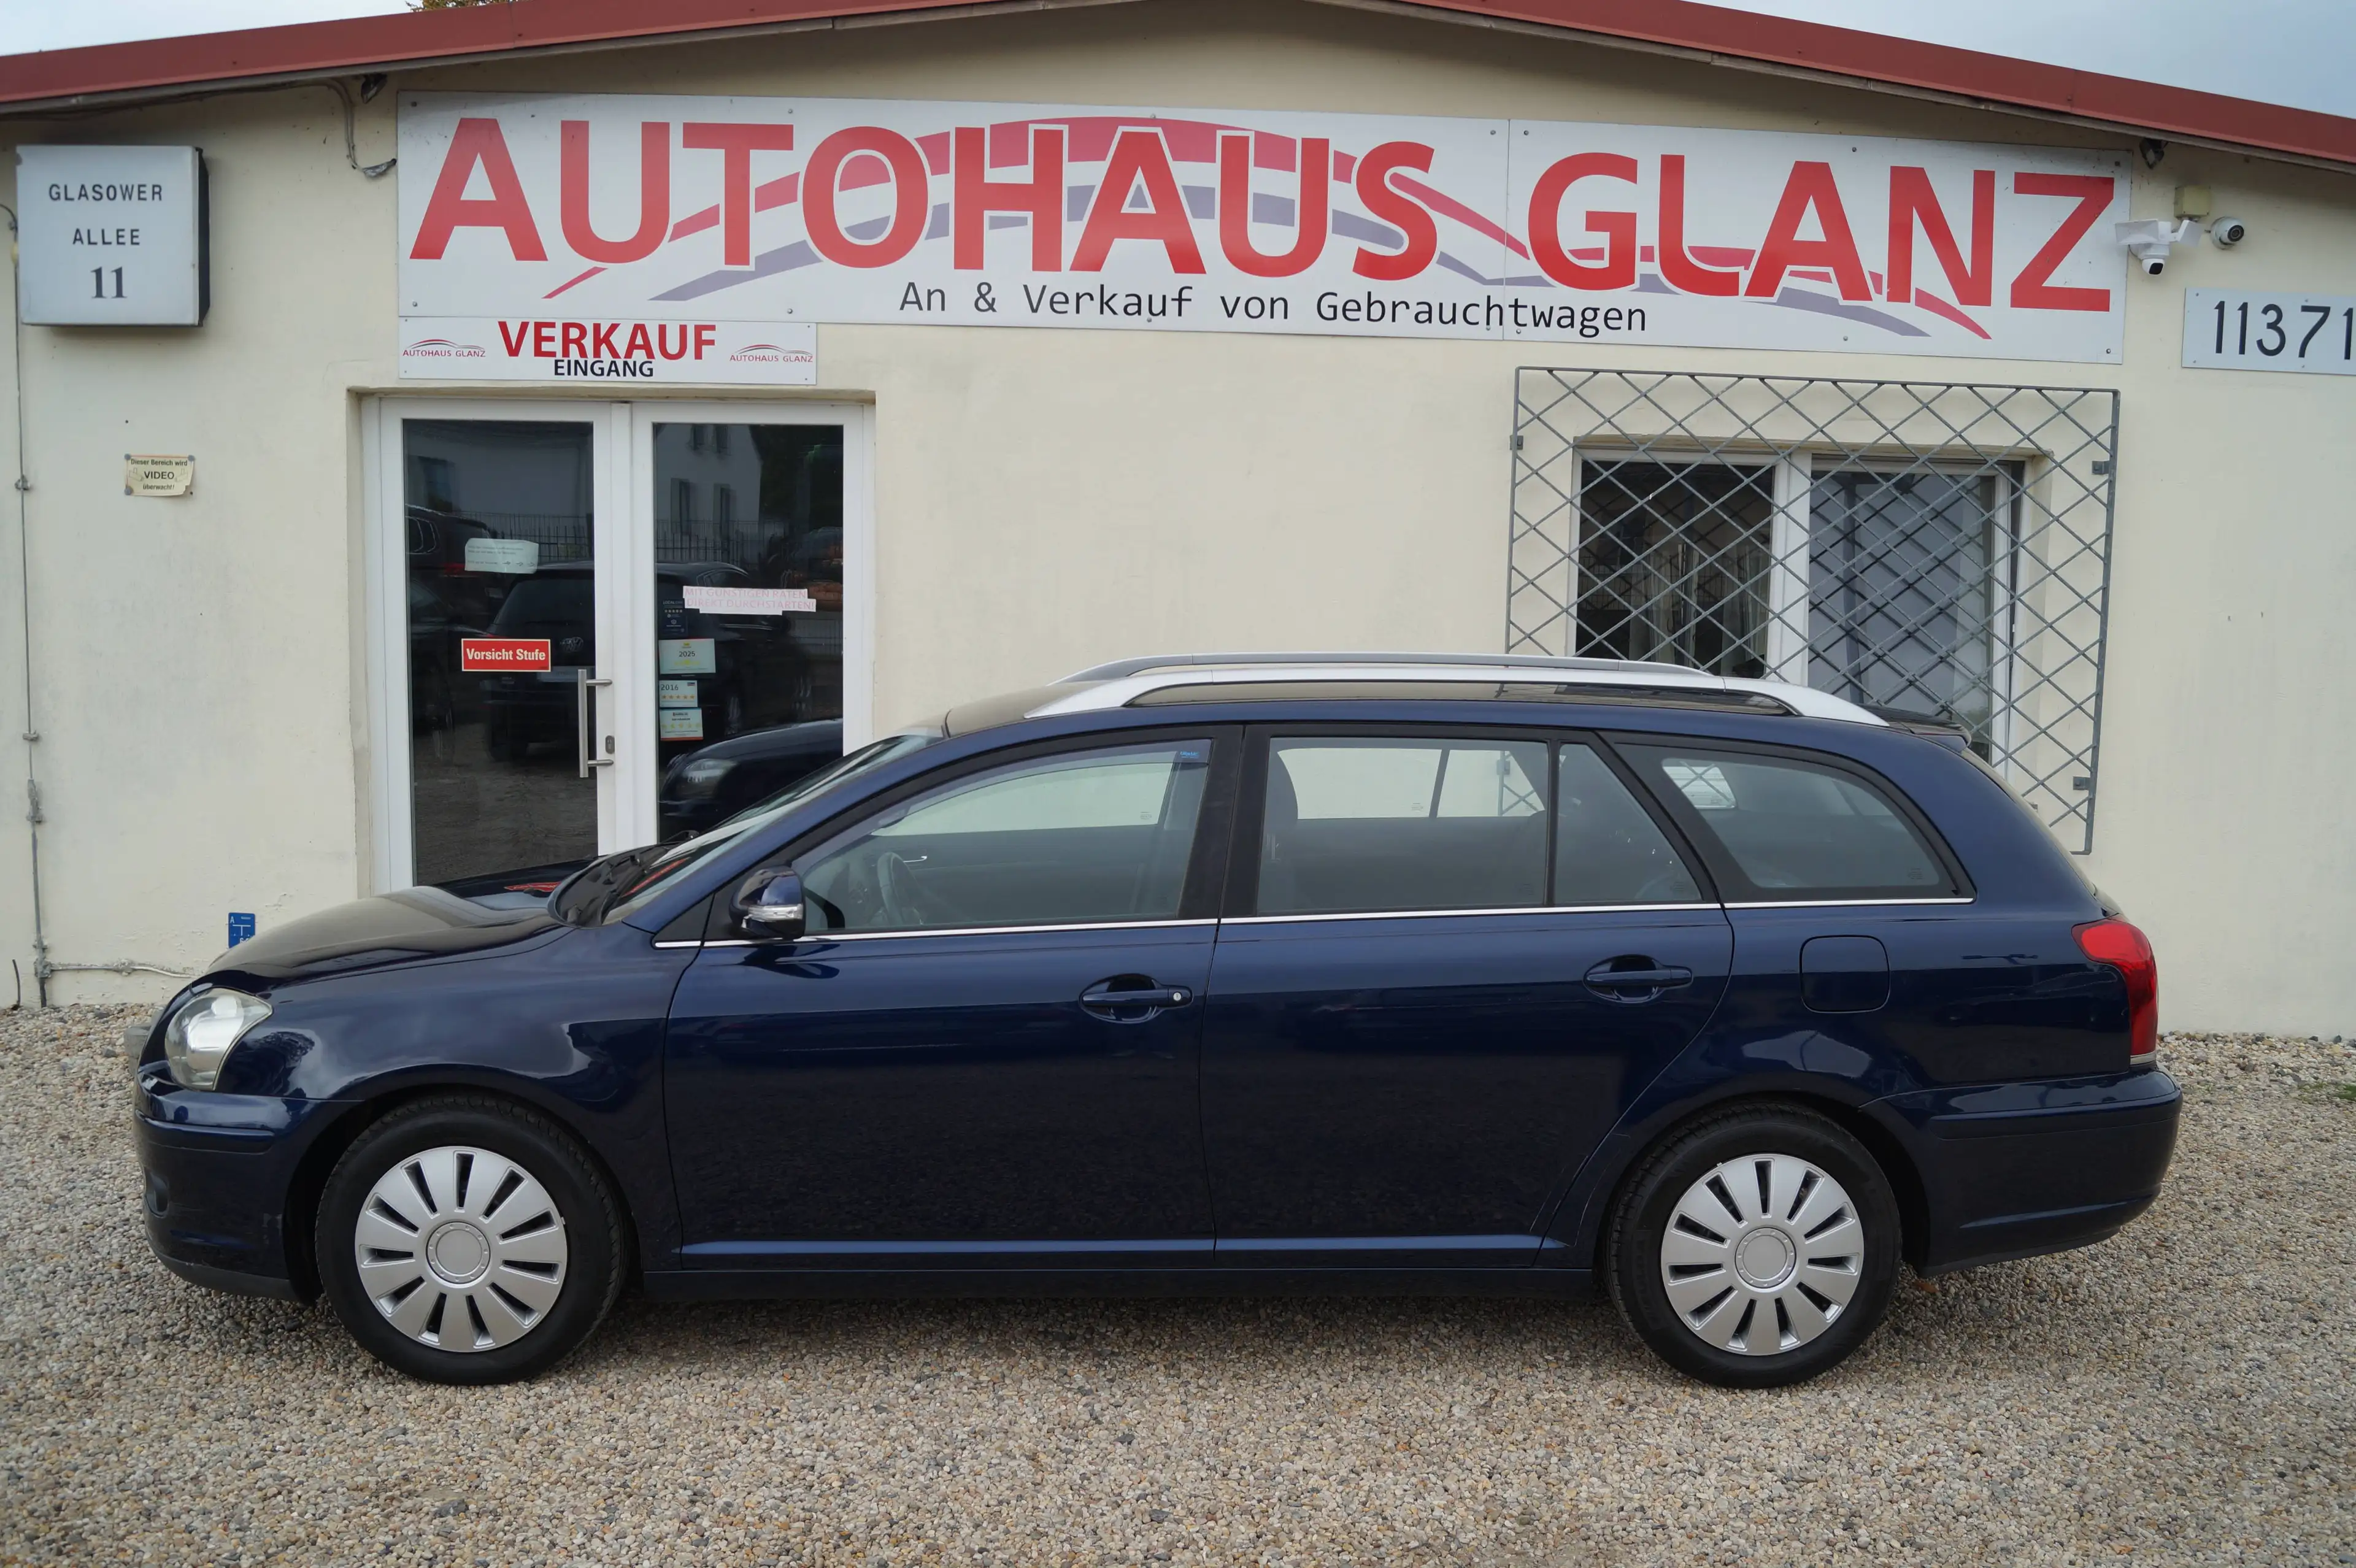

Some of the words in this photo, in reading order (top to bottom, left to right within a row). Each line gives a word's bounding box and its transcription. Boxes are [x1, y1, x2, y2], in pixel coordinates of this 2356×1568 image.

[48, 183, 162, 201] GLASOWER
[409, 117, 1438, 281] AUTOHAUS
[1528, 152, 2115, 313] GLANZ
[72, 228, 140, 245] ALLEE
[90, 266, 128, 299] 11
[899, 282, 945, 311] An
[974, 282, 997, 312] &
[1023, 284, 1192, 317] Verkauf
[1220, 295, 1288, 319] von
[1317, 291, 1646, 337] Gebrauchtwagen
[2214, 301, 2354, 360] 11371
[498, 321, 716, 360] VERKAUF
[554, 359, 653, 377] EINGANG
[144, 471, 175, 480] VIDEO
[687, 598, 723, 607] DIREKT
[773, 590, 806, 599] RATEN
[466, 648, 513, 660] Vorsicht
[516, 648, 546, 661] Stufe
